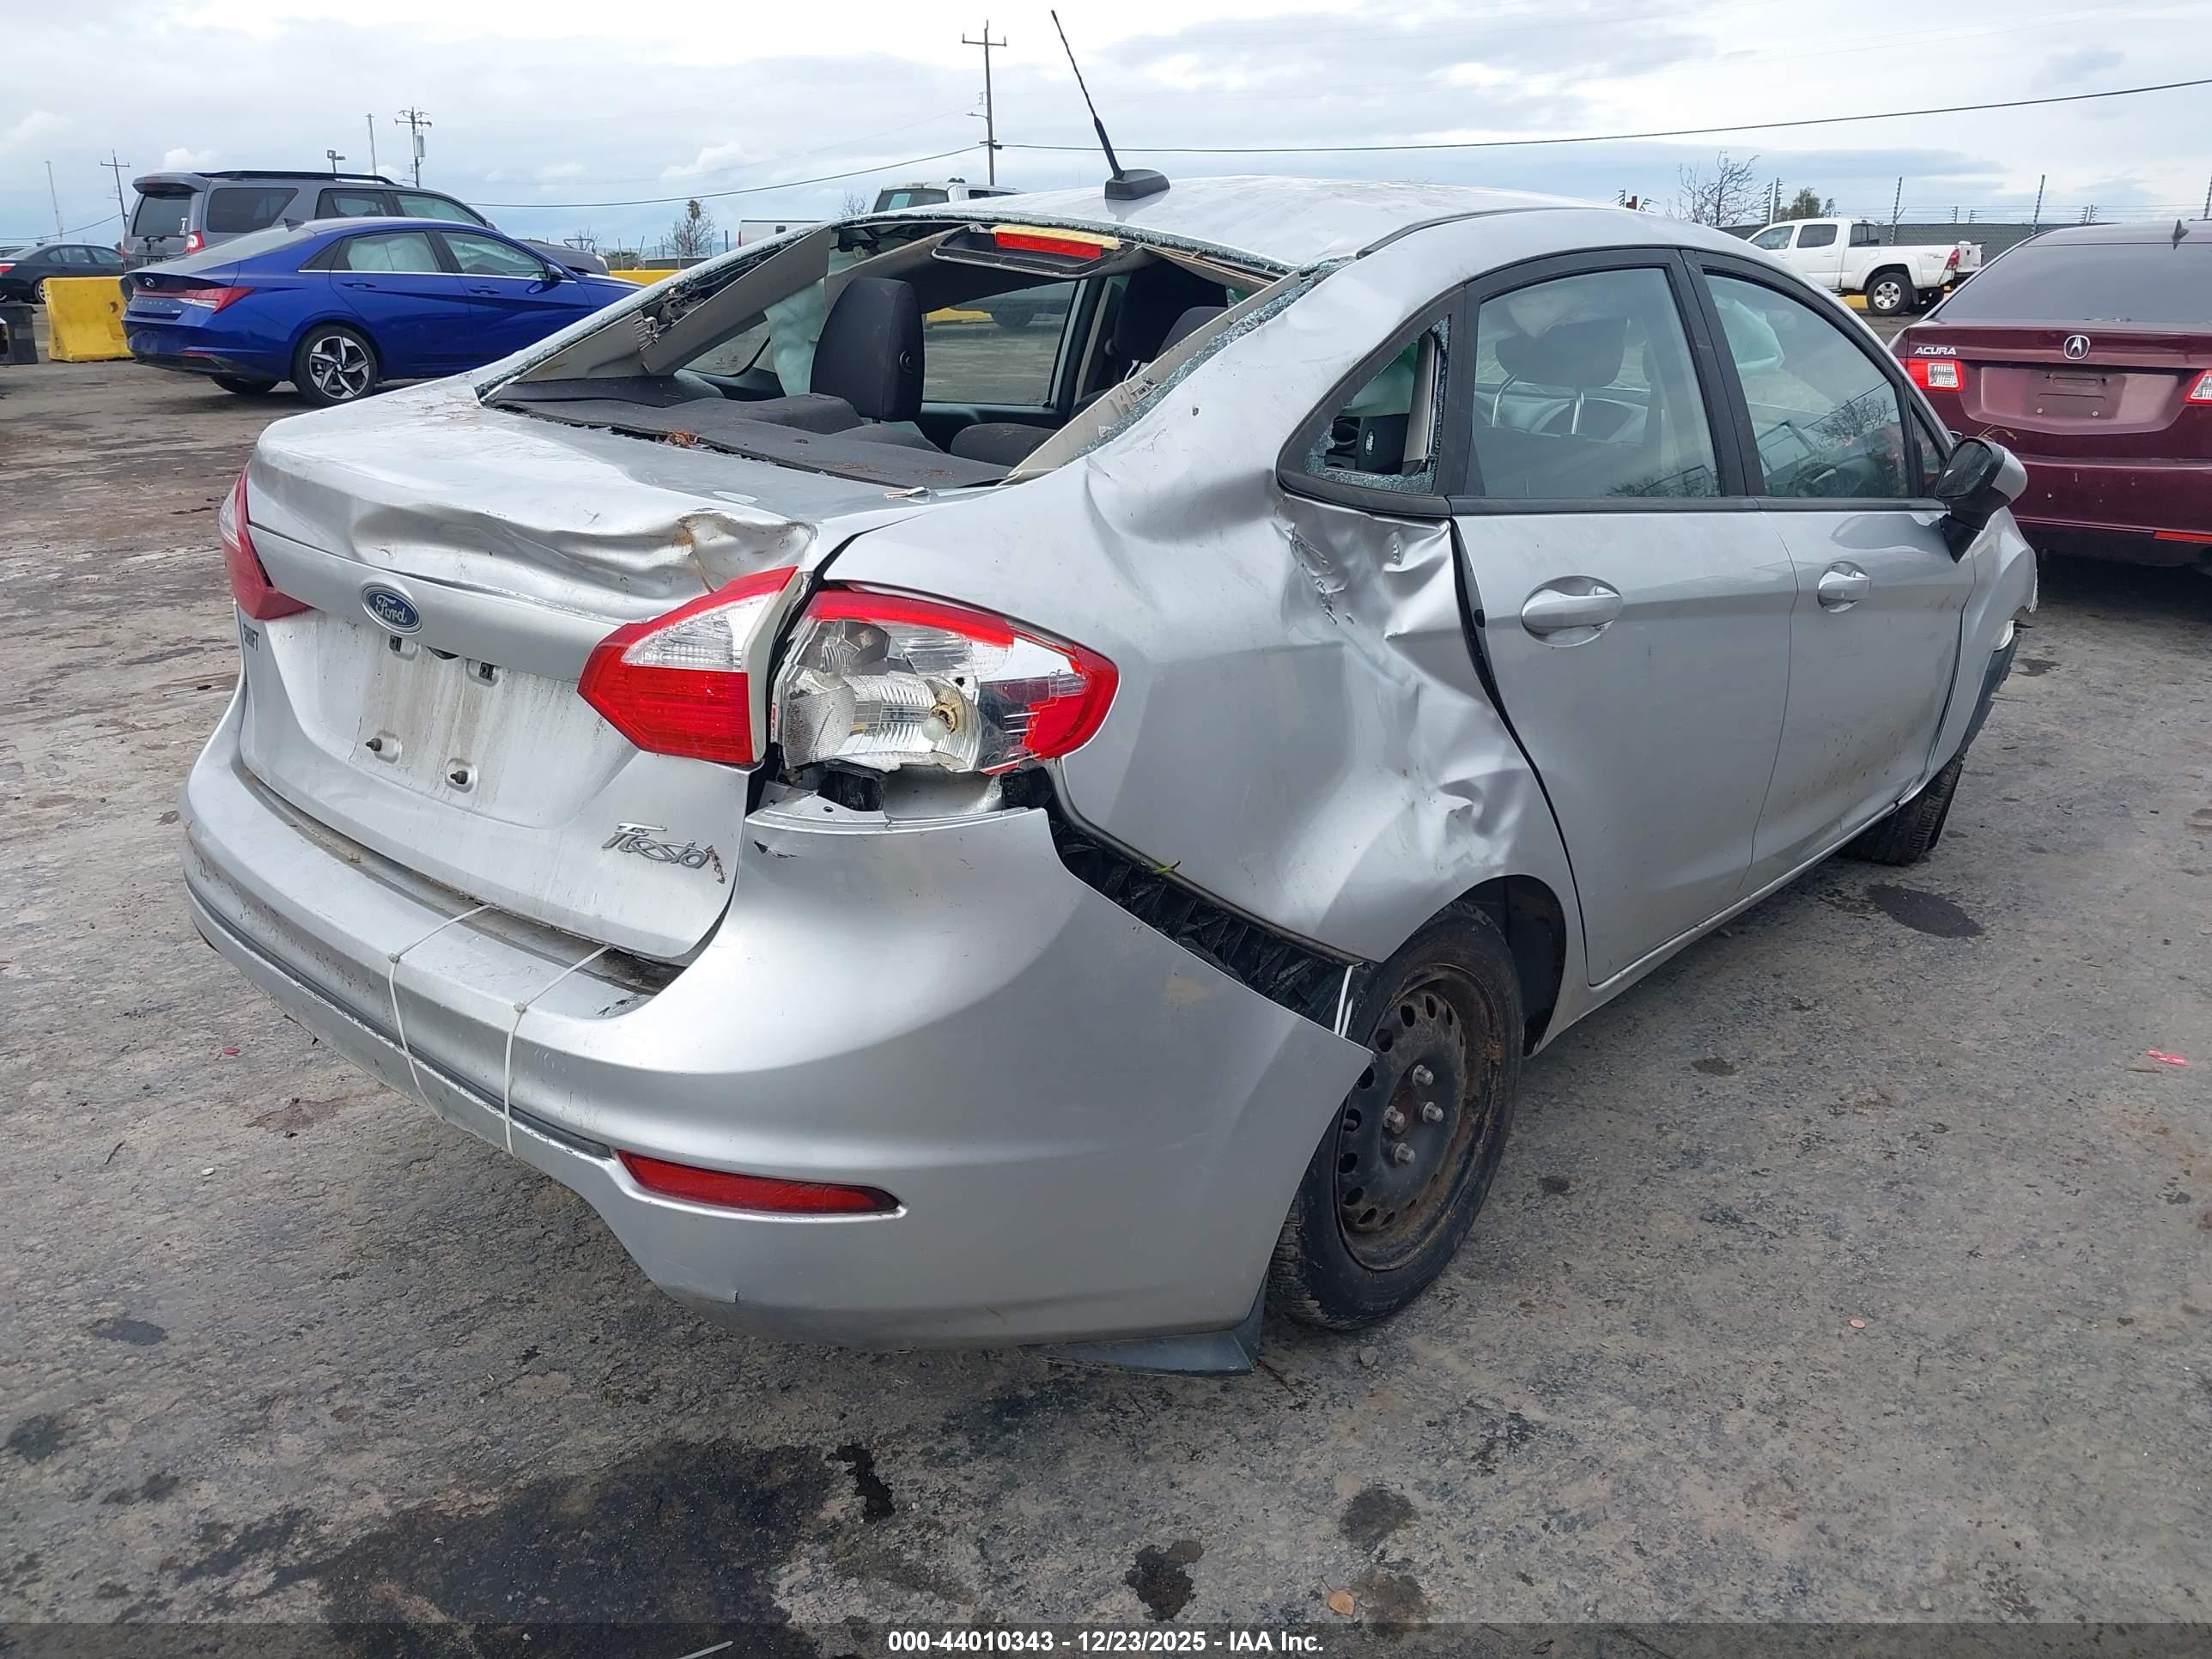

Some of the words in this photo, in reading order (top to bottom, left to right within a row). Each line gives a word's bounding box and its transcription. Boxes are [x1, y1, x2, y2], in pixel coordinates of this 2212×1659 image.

[1914, 346, 1957, 356] ACURA
[375, 594, 408, 623] Ford
[601, 822, 720, 872] Fiesta
